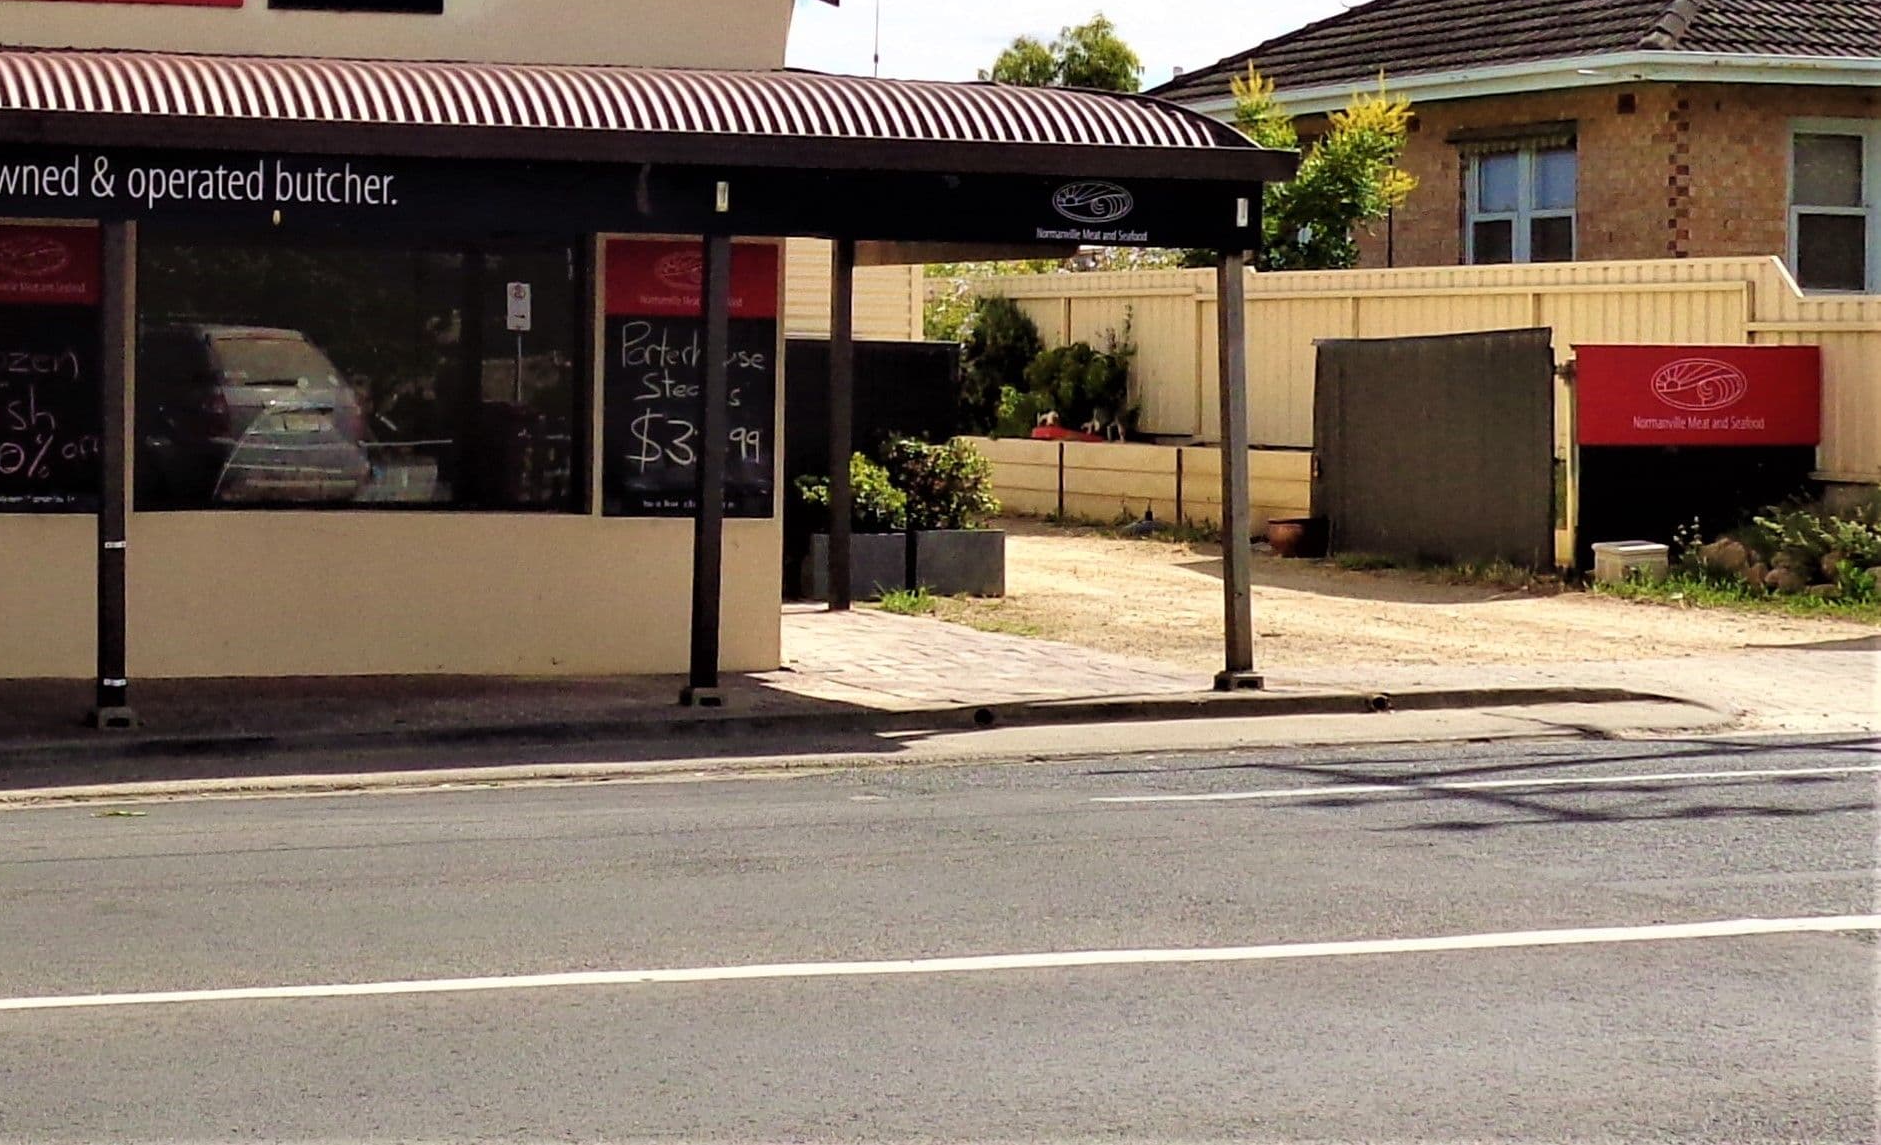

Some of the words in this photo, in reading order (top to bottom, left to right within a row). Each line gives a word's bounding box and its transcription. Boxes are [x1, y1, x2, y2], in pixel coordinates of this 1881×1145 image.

[90, 156, 116, 199] &
[127, 160, 263, 209] operated
[274, 162, 399, 206] butcher.
[1632, 415, 1686, 430] Normanville
[1687, 416, 1710, 430] Meat
[1711, 416, 1729, 430] and
[1730, 415, 1765, 430] Seafood
